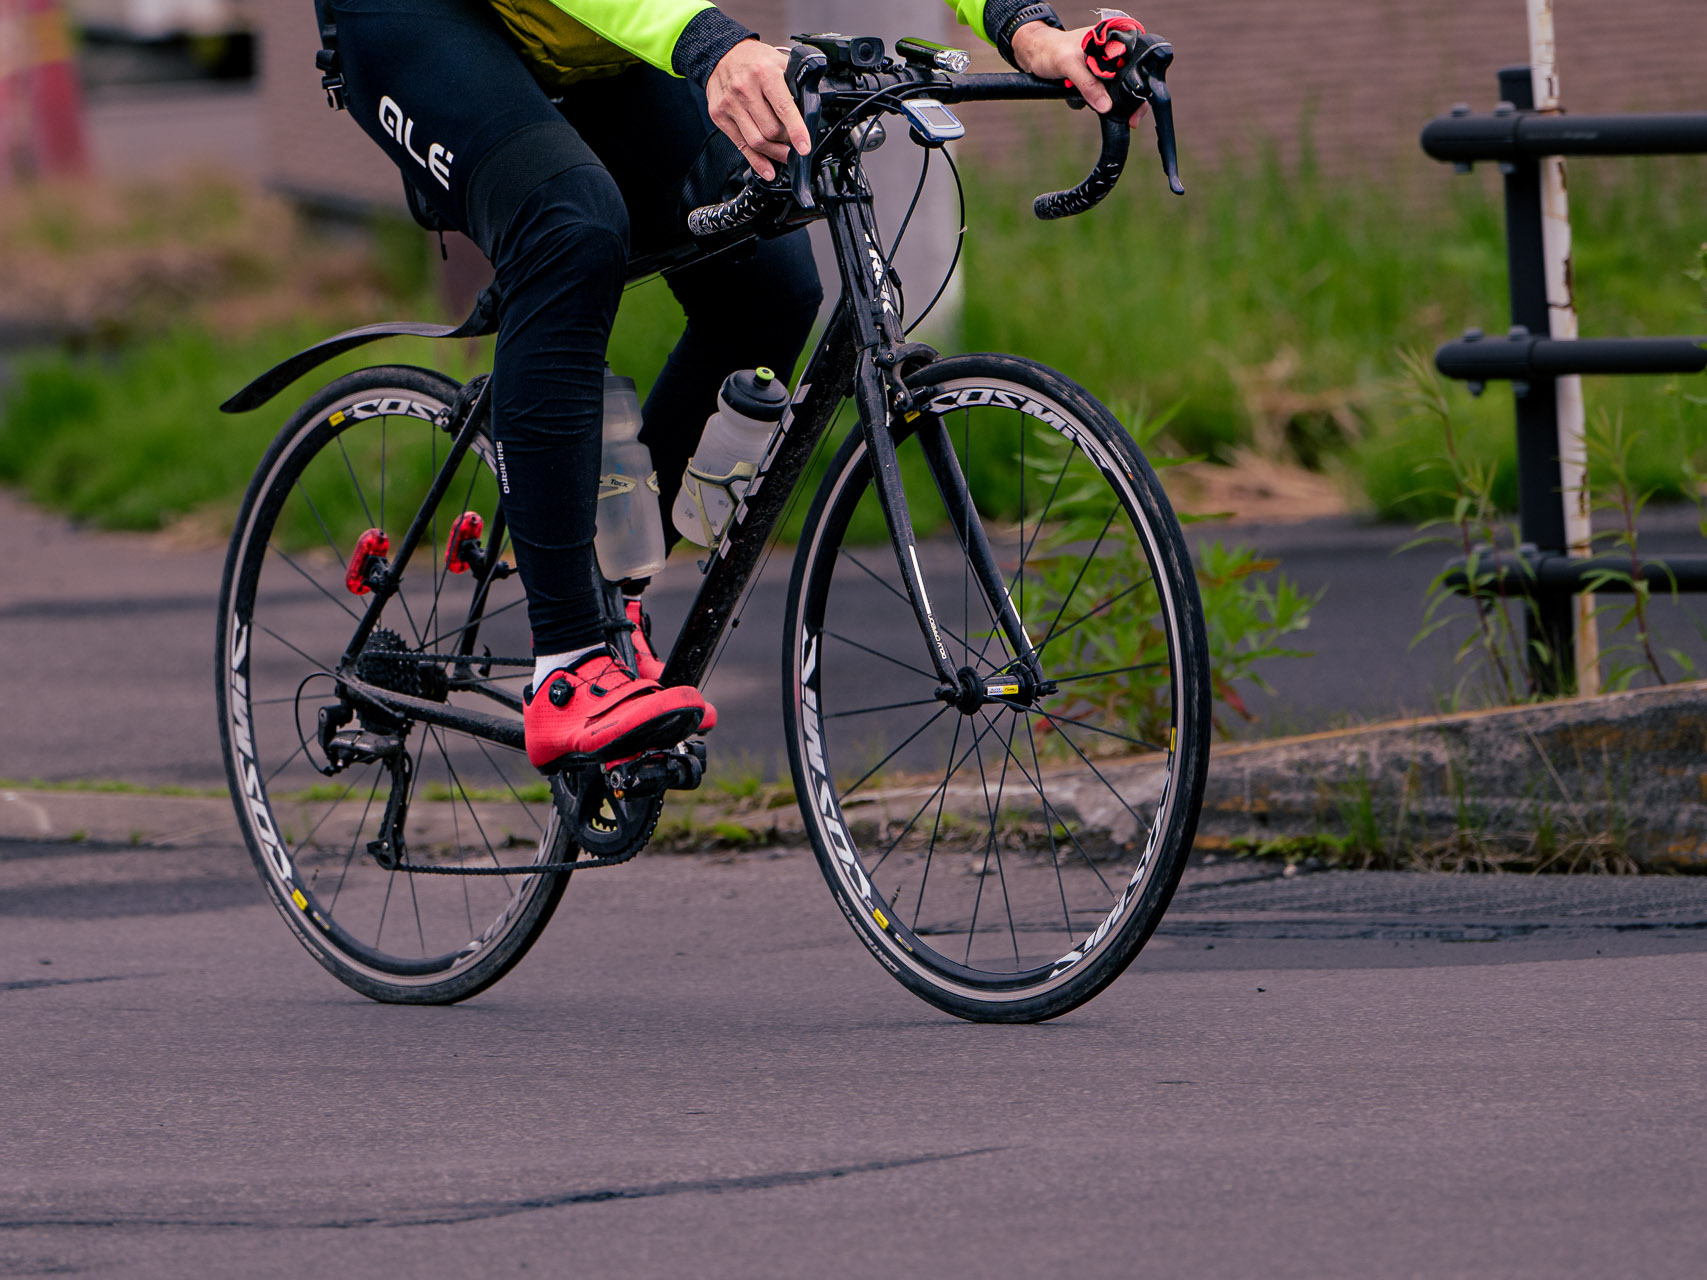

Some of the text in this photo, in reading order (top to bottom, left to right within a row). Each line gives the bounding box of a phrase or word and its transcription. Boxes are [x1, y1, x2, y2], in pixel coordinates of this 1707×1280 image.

[496, 441, 510, 494] SHIMANO
[928, 387, 1112, 473] COSMIC
[231, 611, 293, 882] COSMIC
[801, 622, 873, 901] COSMIC
